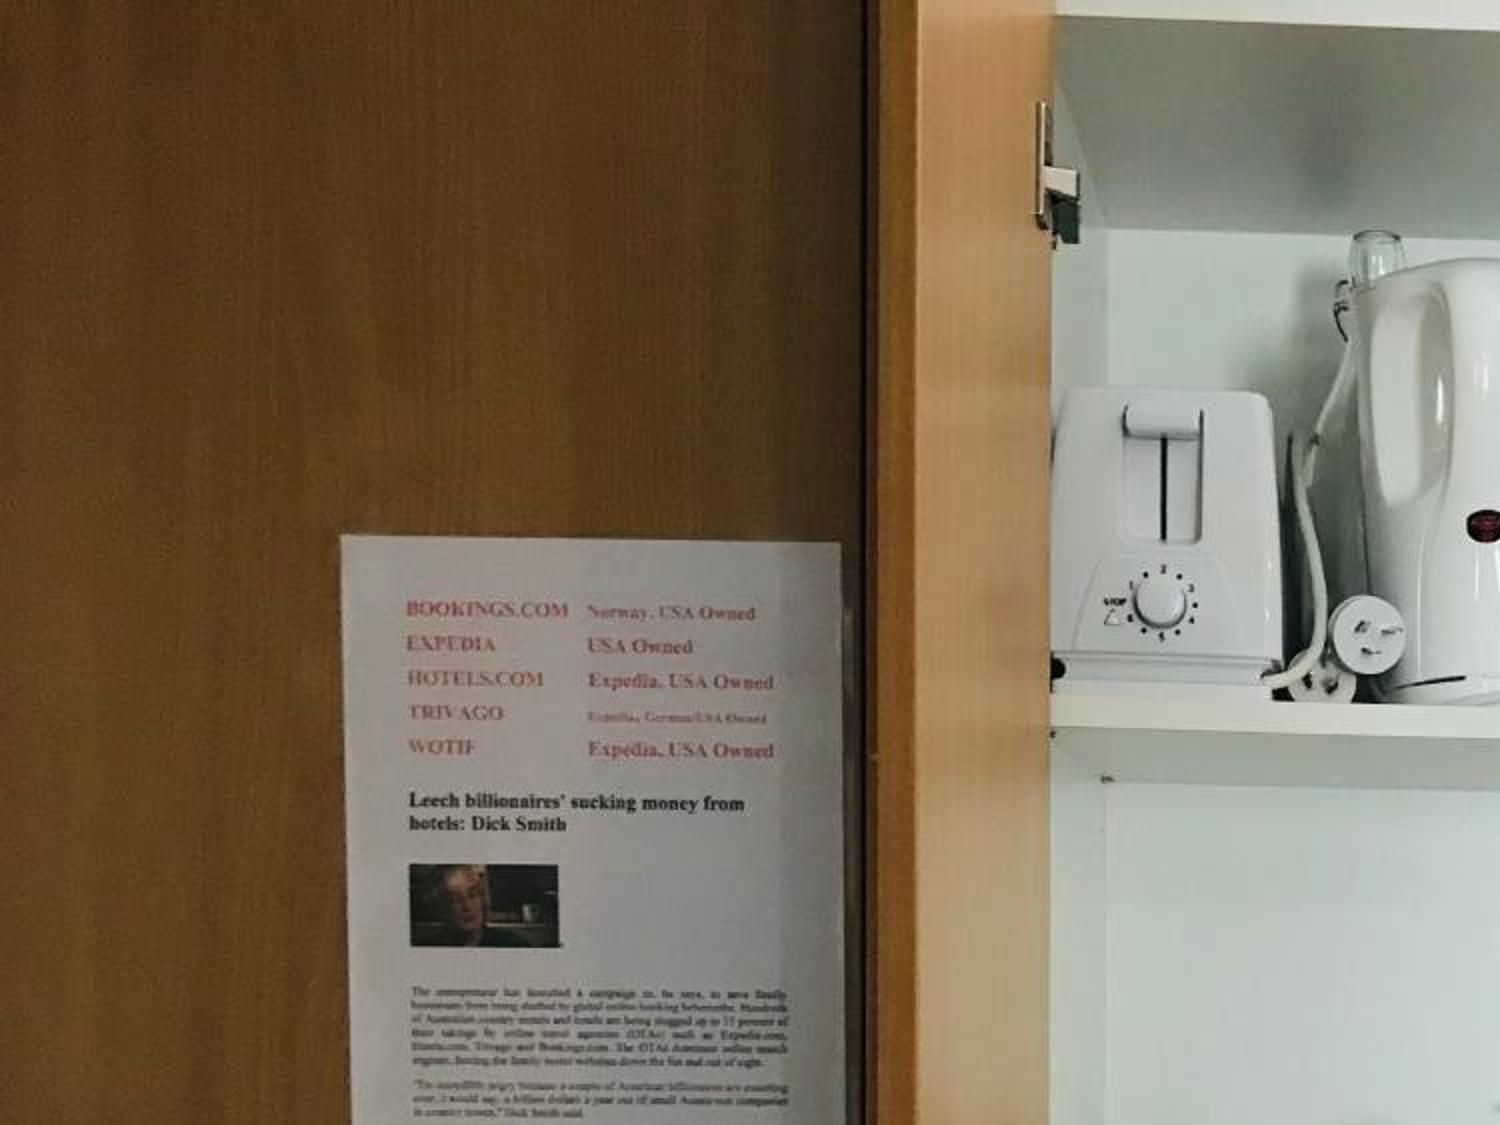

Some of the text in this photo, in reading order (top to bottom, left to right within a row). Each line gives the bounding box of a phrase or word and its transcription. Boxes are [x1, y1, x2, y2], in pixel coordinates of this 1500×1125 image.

[407, 600, 569, 619] BOOKINGS.COM
[658, 605, 695, 620] USA
[700, 607, 757, 622] Owned
[407, 635, 496, 652] EXPEDIA
[587, 637, 694, 655] USA Owned
[669, 673, 708, 689] USA
[713, 674, 775, 690] Owned
[409, 703, 505, 721] TRIVAGO
[408, 737, 478, 756] WOTIF
[669, 741, 708, 758] USA
[713, 742, 775, 758] Owned
[409, 791, 461, 809] Leech
[571, 794, 637, 815] sucking
[641, 798, 699, 815] money
[703, 795, 746, 812] from
[409, 815, 568, 833] hotels: Dick Smith
